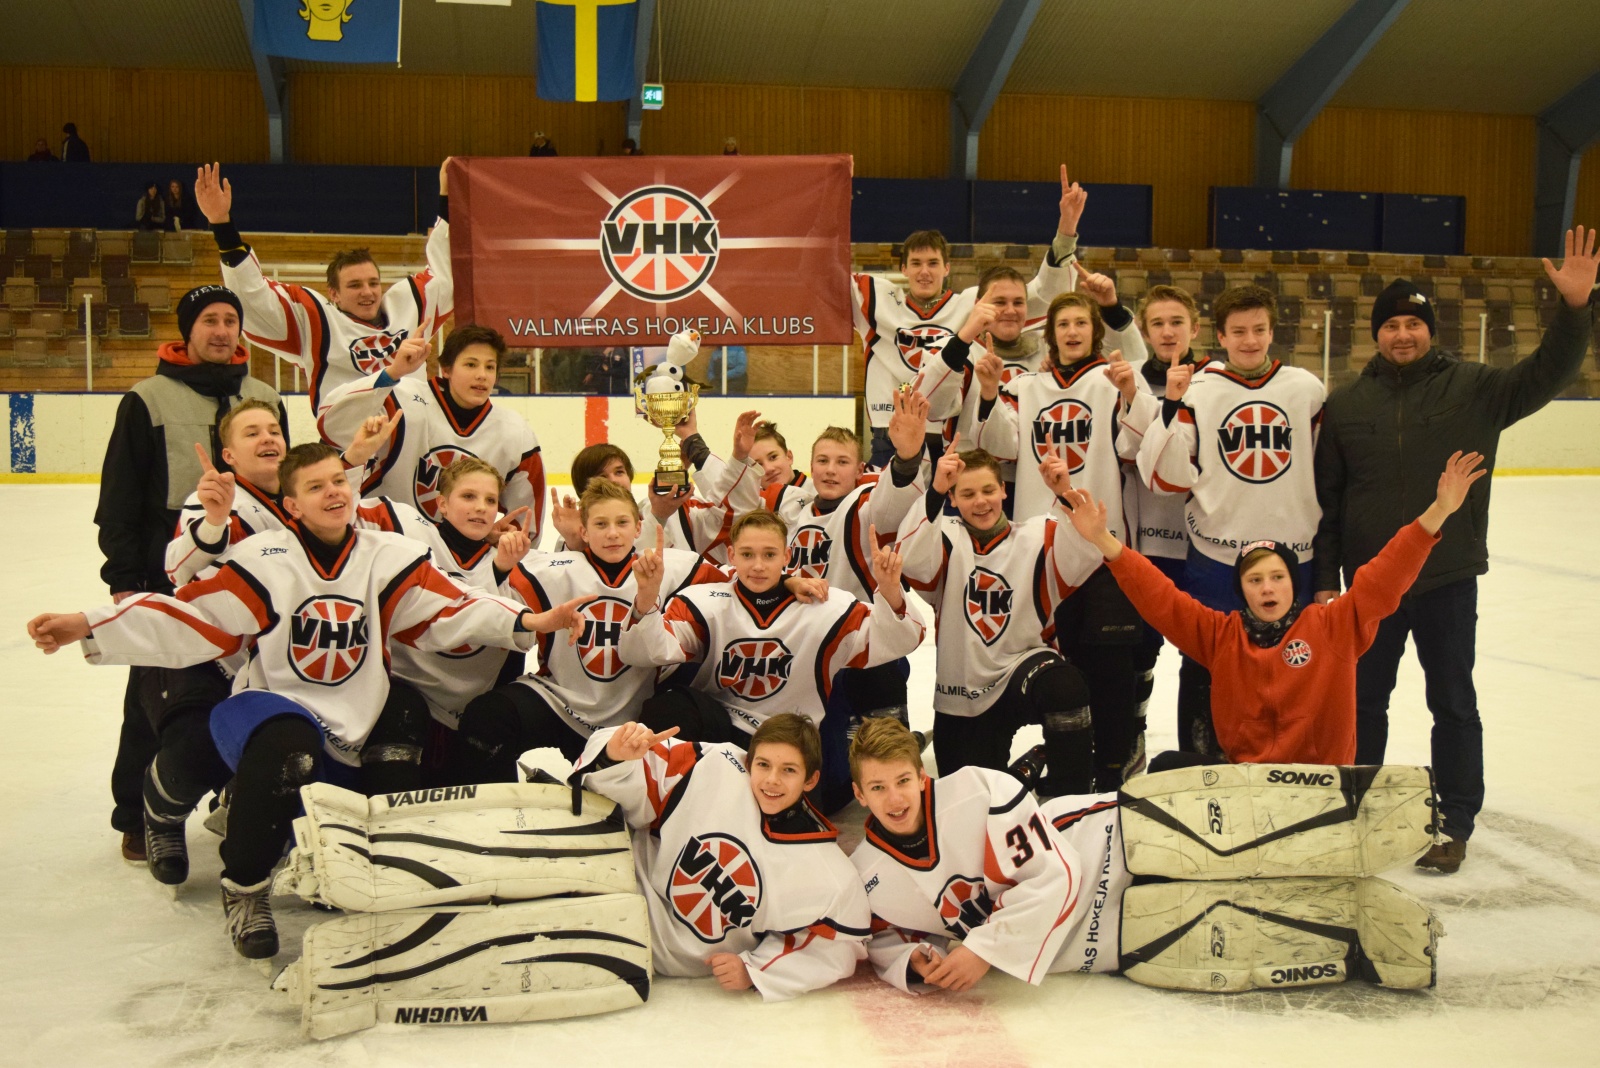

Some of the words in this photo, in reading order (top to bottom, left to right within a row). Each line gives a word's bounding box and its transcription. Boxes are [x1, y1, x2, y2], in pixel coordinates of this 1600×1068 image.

[604, 222, 716, 255] VHK
[508, 317, 640, 336] VALMIERAS
[645, 316, 738, 335] HOKEJA
[743, 316, 815, 335] KLUBS
[1032, 417, 1093, 445] VHK
[1217, 424, 1293, 453] VHK
[1140, 527, 1184, 541] HOKEJA
[1291, 542, 1312, 552] KLU
[291, 614, 369, 650] VHK
[577, 619, 622, 647] VH
[721, 651, 794, 680] VHK
[1283, 645, 1308, 659] VHK
[1266, 770, 1335, 787] SONIC
[386, 785, 478, 808] VAUGHN
[1005, 811, 1053, 869] 31
[679, 835, 758, 928] VHK
[1086, 878, 1110, 943] HOKEJA
[1271, 963, 1338, 984] SONIC
[394, 1005, 488, 1024] VAUGHN
